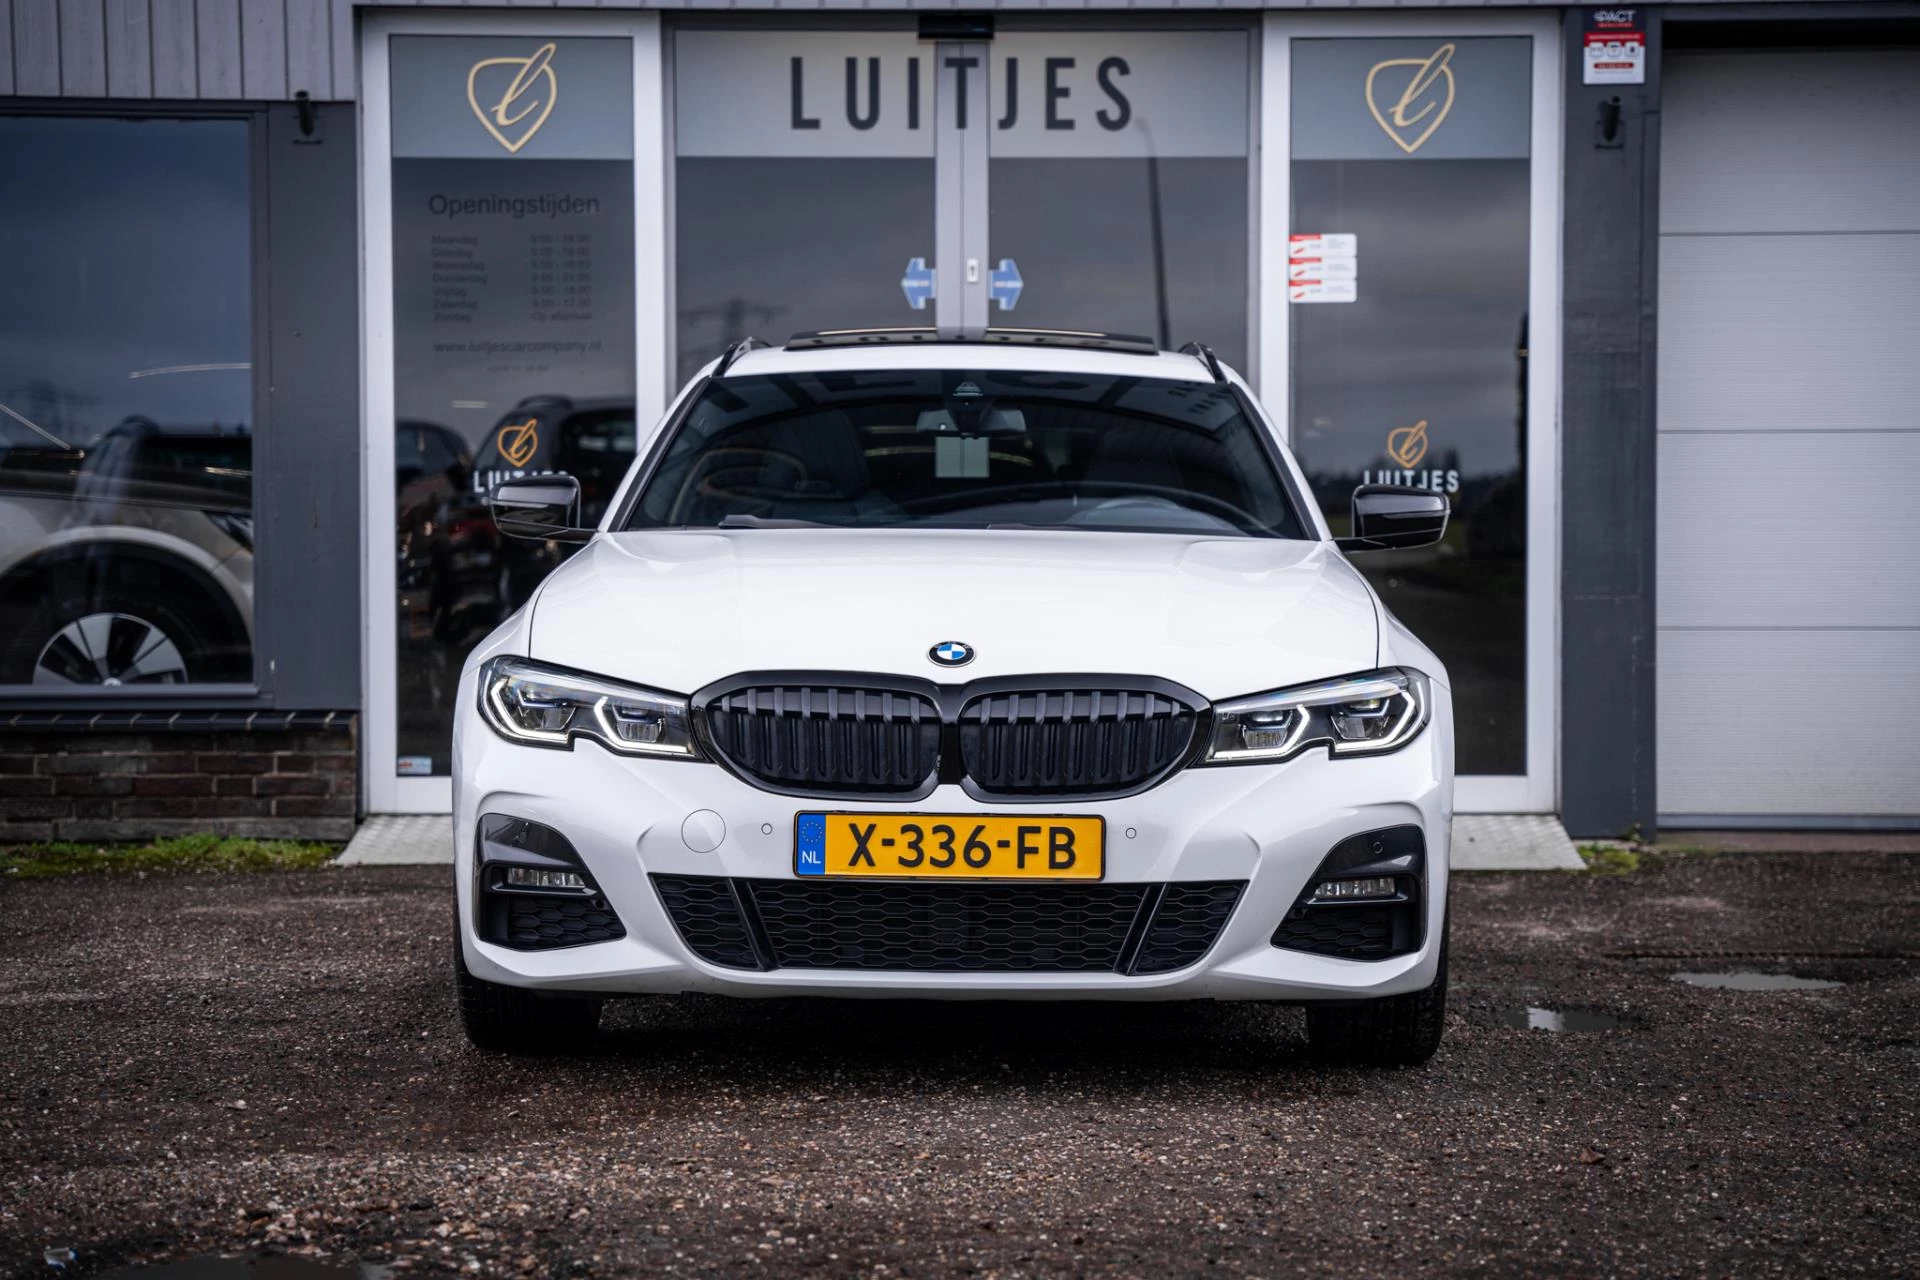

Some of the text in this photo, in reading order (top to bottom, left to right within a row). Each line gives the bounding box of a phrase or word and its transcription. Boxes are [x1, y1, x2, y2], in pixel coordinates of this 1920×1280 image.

[790, 56, 1131, 131] LUITJES
[428, 193, 600, 219] Openingstijden
[801, 850, 821, 864] NL
[848, 823, 1076, 870] X-336-FB
